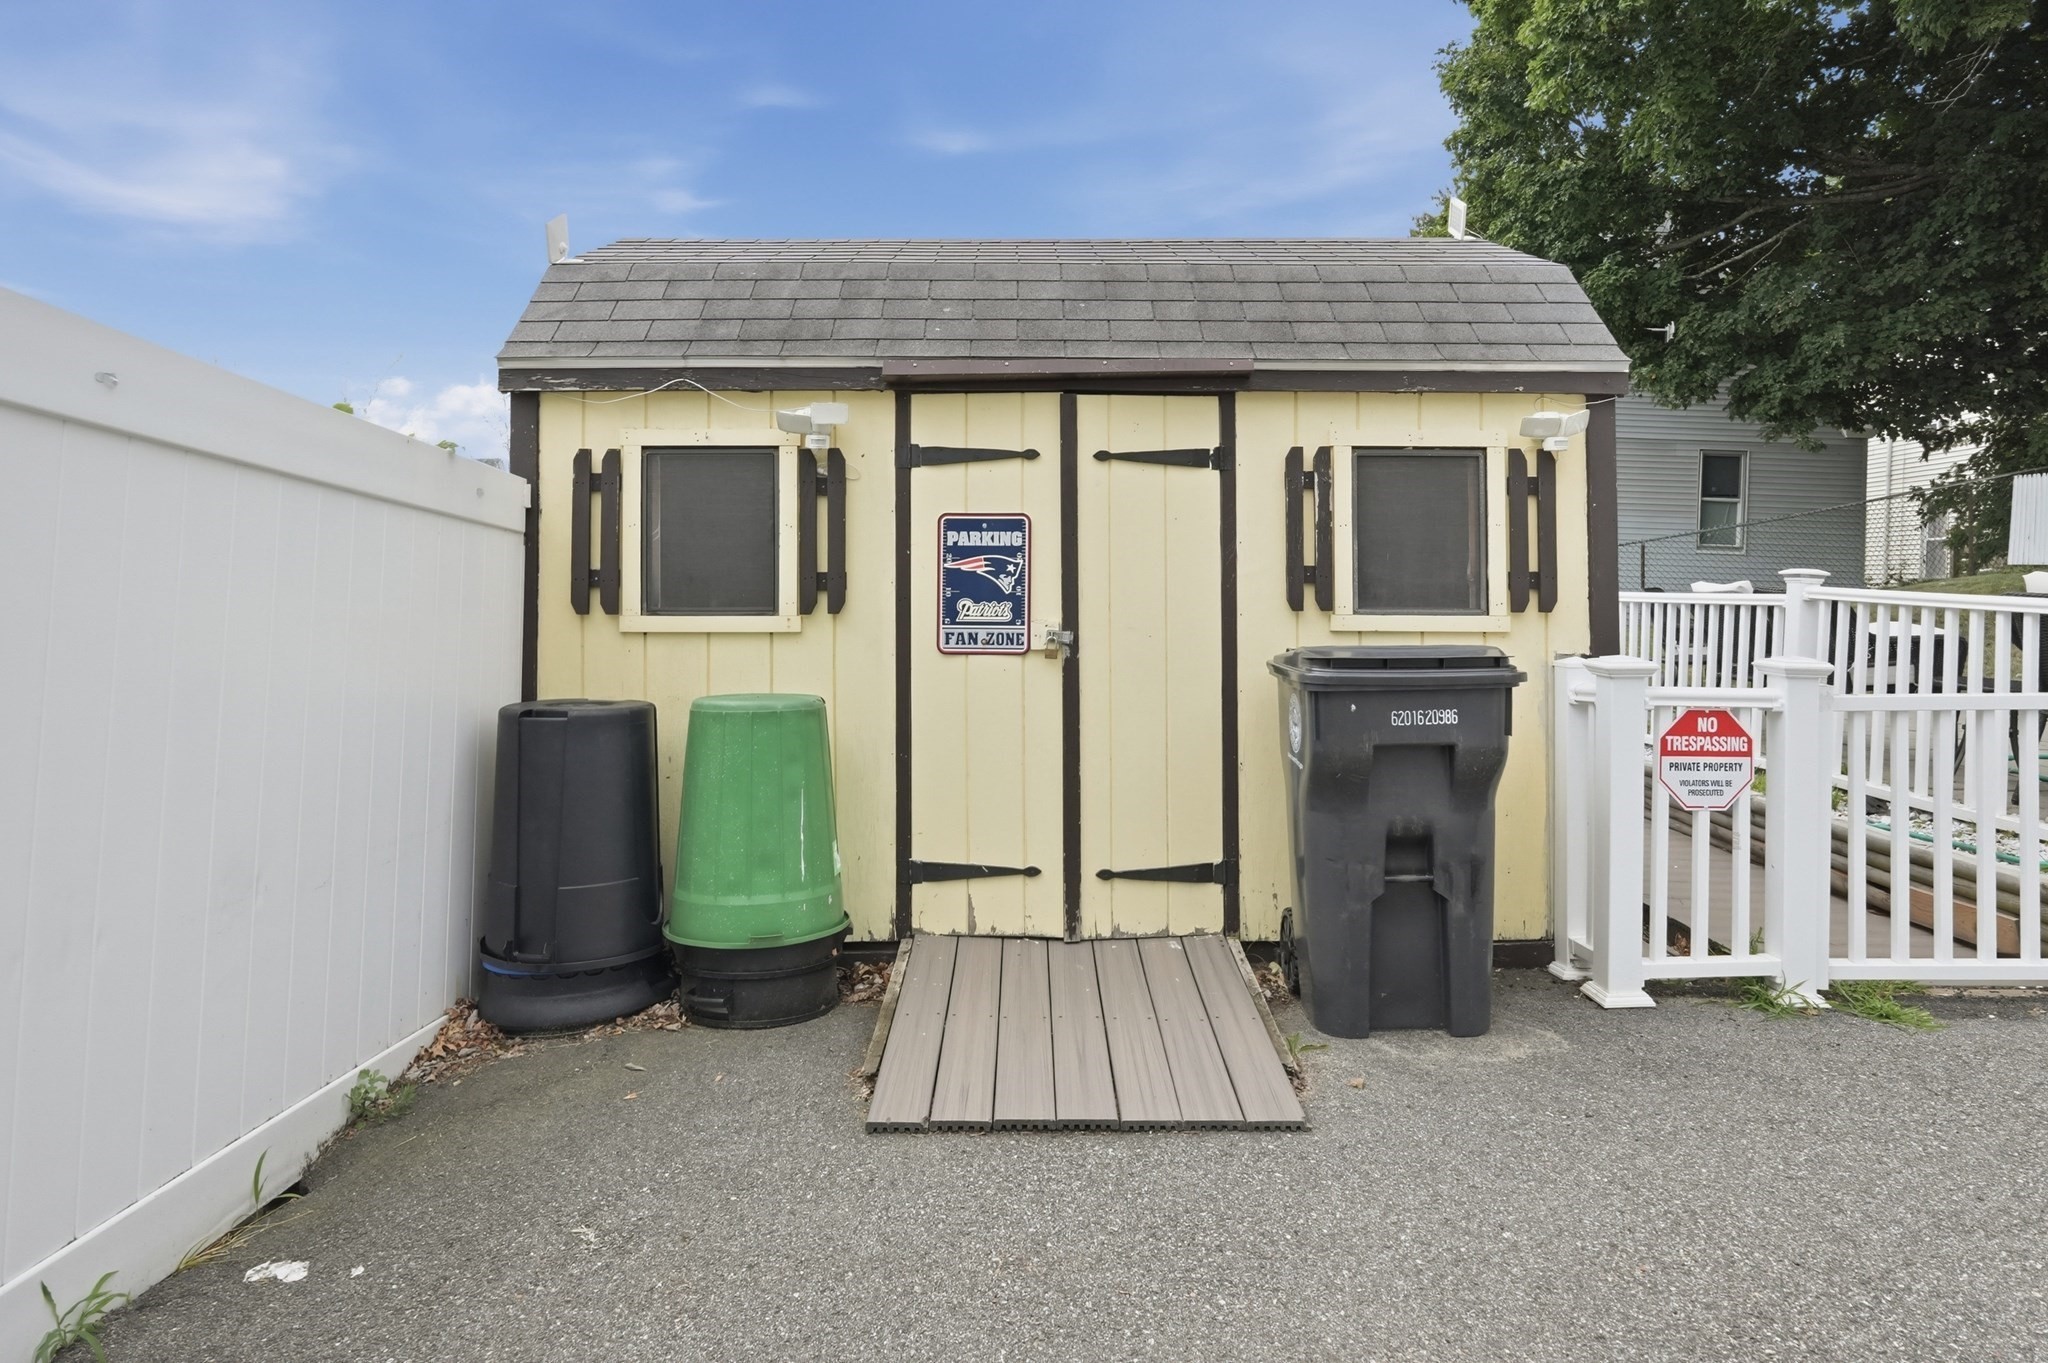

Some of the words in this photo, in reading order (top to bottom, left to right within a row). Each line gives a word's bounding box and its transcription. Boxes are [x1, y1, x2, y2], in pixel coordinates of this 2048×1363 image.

[946, 531, 1023, 547] PARKING
[956, 598, 1013, 622] Patriots
[945, 632, 979, 646] FAN
[986, 632, 1025, 646] ZONE
[1391, 709, 1459, 726] 6201620986
[1697, 717, 1718, 733] NO
[1665, 735, 1748, 752] TRESPASSING
[1669, 762, 1701, 772] PRIVATE
[1703, 762, 1743, 772] PROPERTY
[1688, 789, 1724, 797] PROSECUTED
